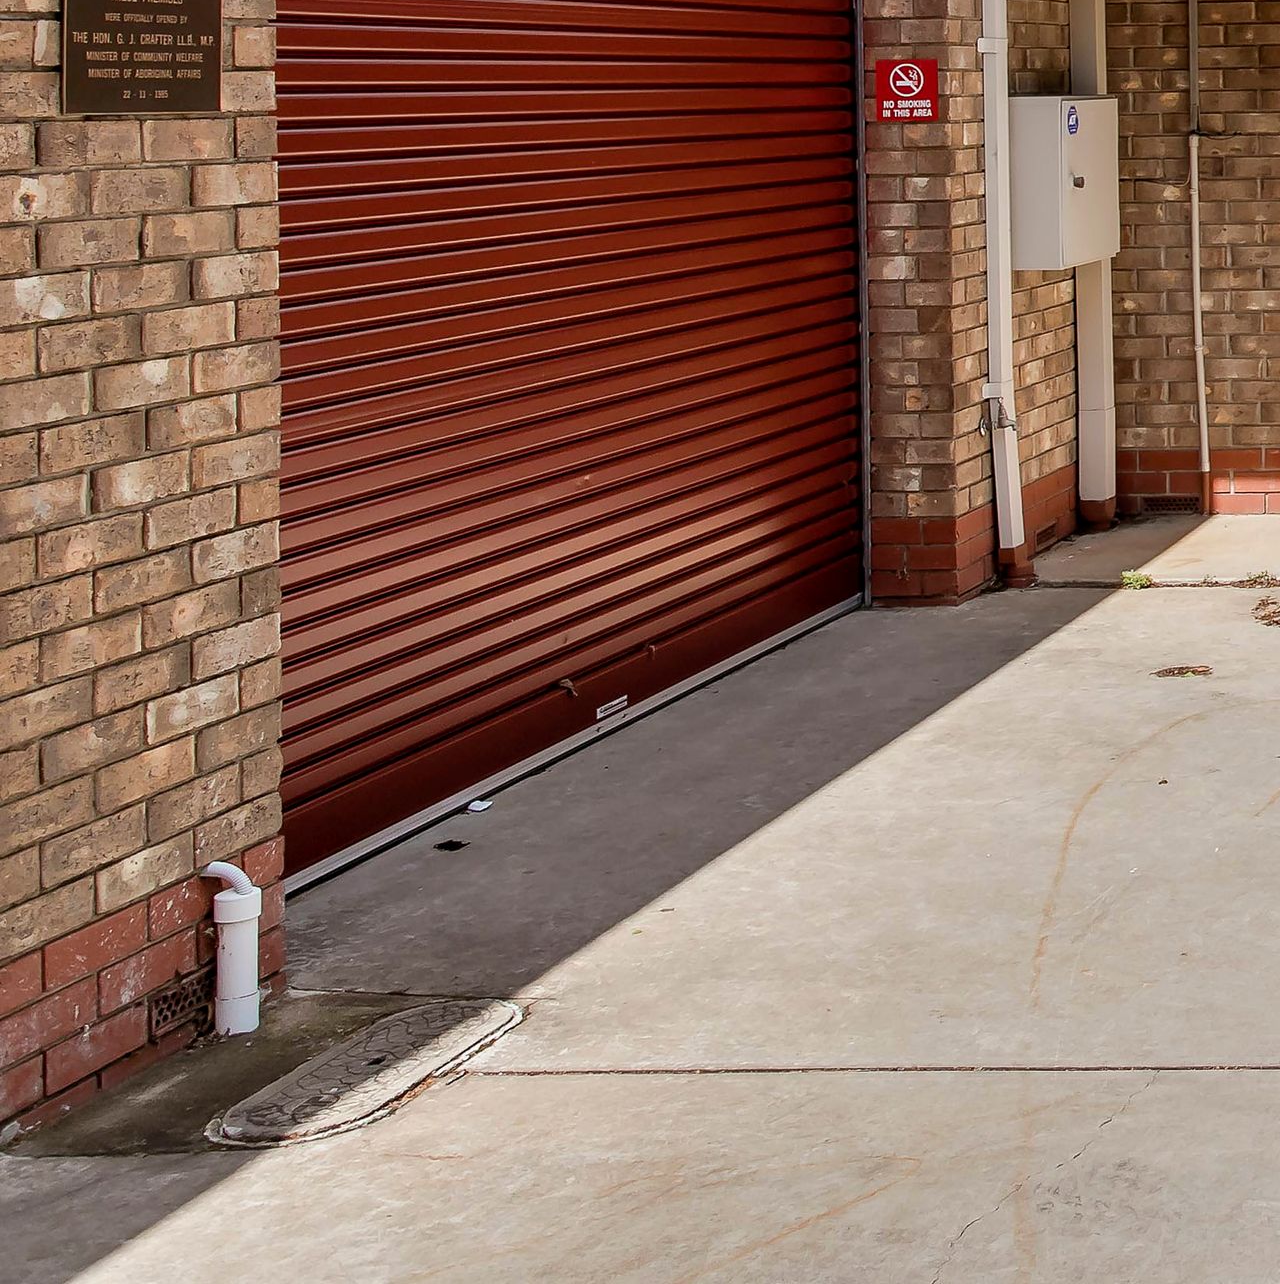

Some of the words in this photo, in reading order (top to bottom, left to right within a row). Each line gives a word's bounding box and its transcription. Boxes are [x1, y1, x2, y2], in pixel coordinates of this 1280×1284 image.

[104, 12, 121, 22] WERE
[179, 15, 188, 24] BY
[72, 31, 88, 44] THE
[92, 32, 113, 44] HON.
[116, 33, 125, 45] G.
[128, 33, 136, 45] J.
[140, 34, 173, 46] CRAFTER
[200, 35, 216, 47] M.P.
[86, 51, 118, 62] MINISTER
[121, 51, 130, 62] OF
[133, 52, 173, 62] COMMUNITY
[175, 52, 204, 63] WELFARE
[88, 68, 120, 79] MINISTER
[123, 69, 132, 79] OF
[135, 69, 174, 79] ABORIGINAL
[176, 69, 202, 79] AFFAIRS
[897, 100, 931, 108] SMOKING
[893, 109, 910, 117] THIS
[913, 109, 932, 117] AREA
